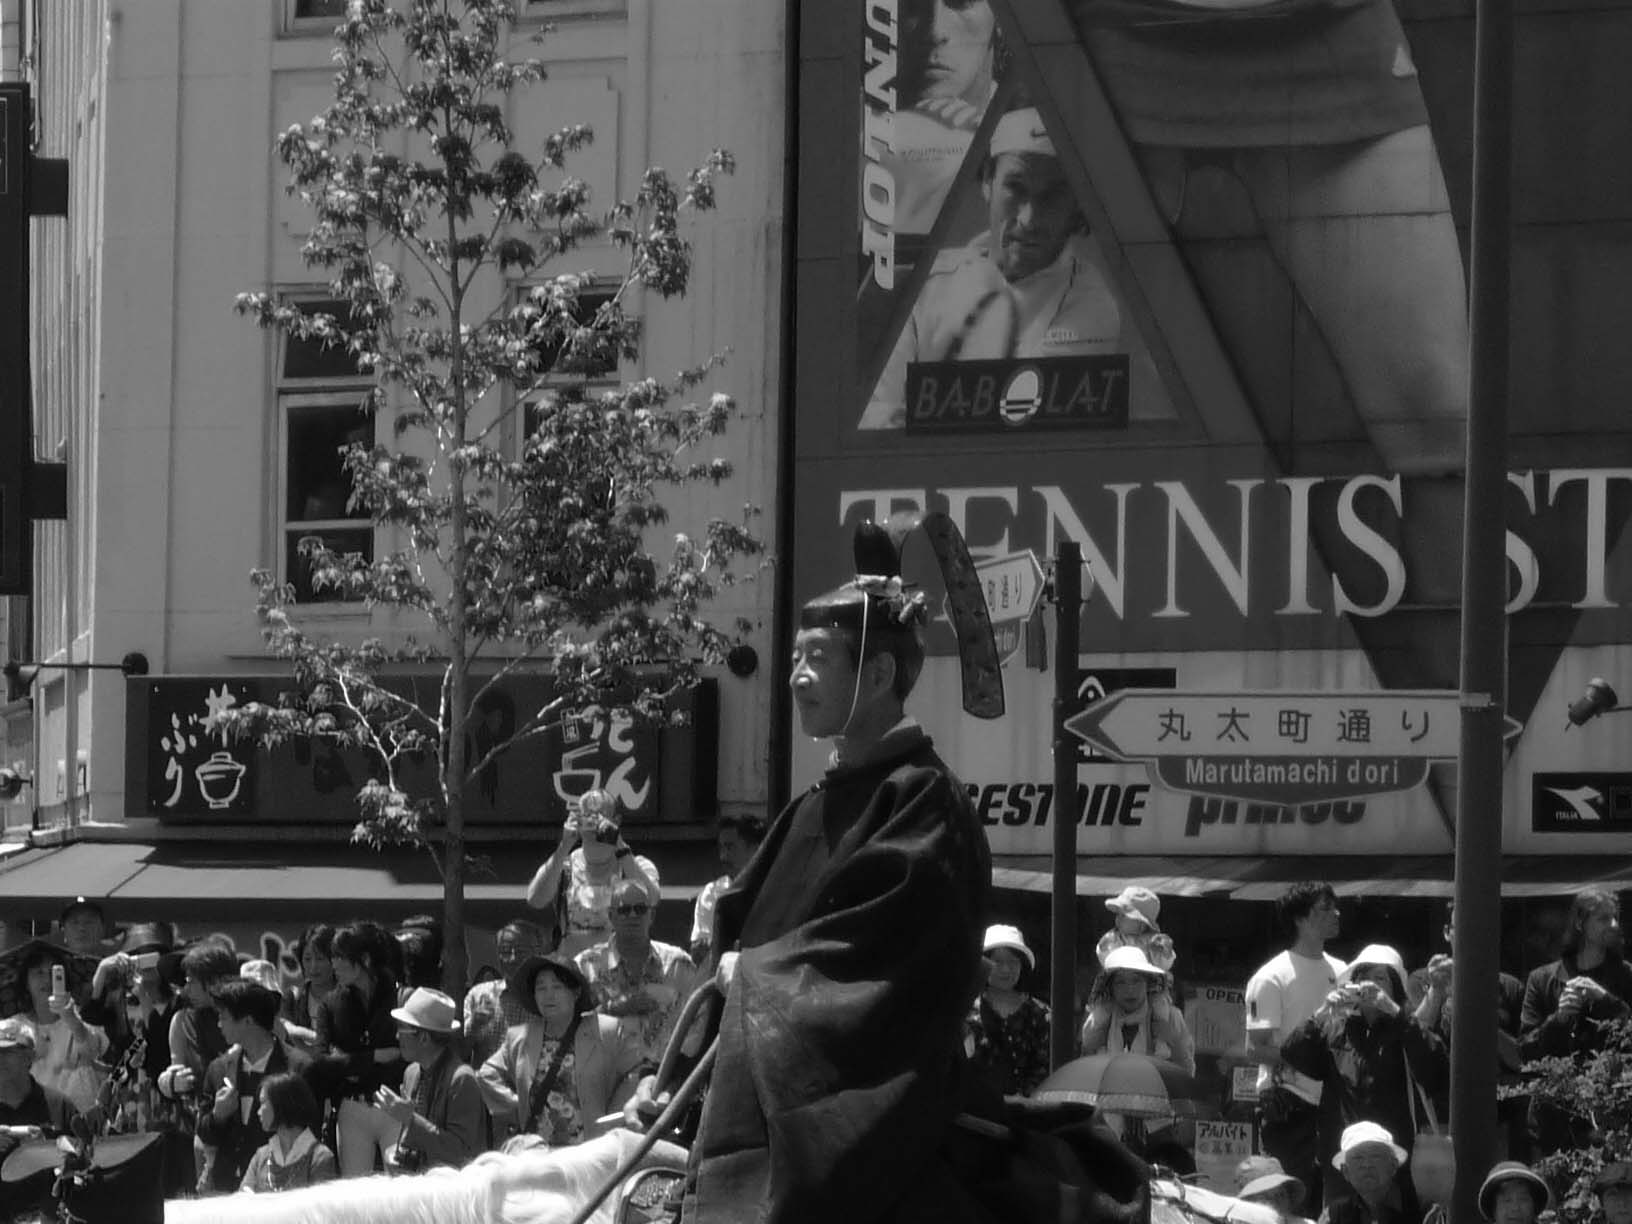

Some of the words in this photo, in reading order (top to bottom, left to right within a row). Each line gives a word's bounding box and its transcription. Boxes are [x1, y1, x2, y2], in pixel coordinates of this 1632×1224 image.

[1157, 706, 1432, 745] 丸太町通り
[1185, 756, 1339, 786] Marutamachi
[1346, 756, 1400, 786] dori
[1197, 1122, 1248, 1141] アルバイト
